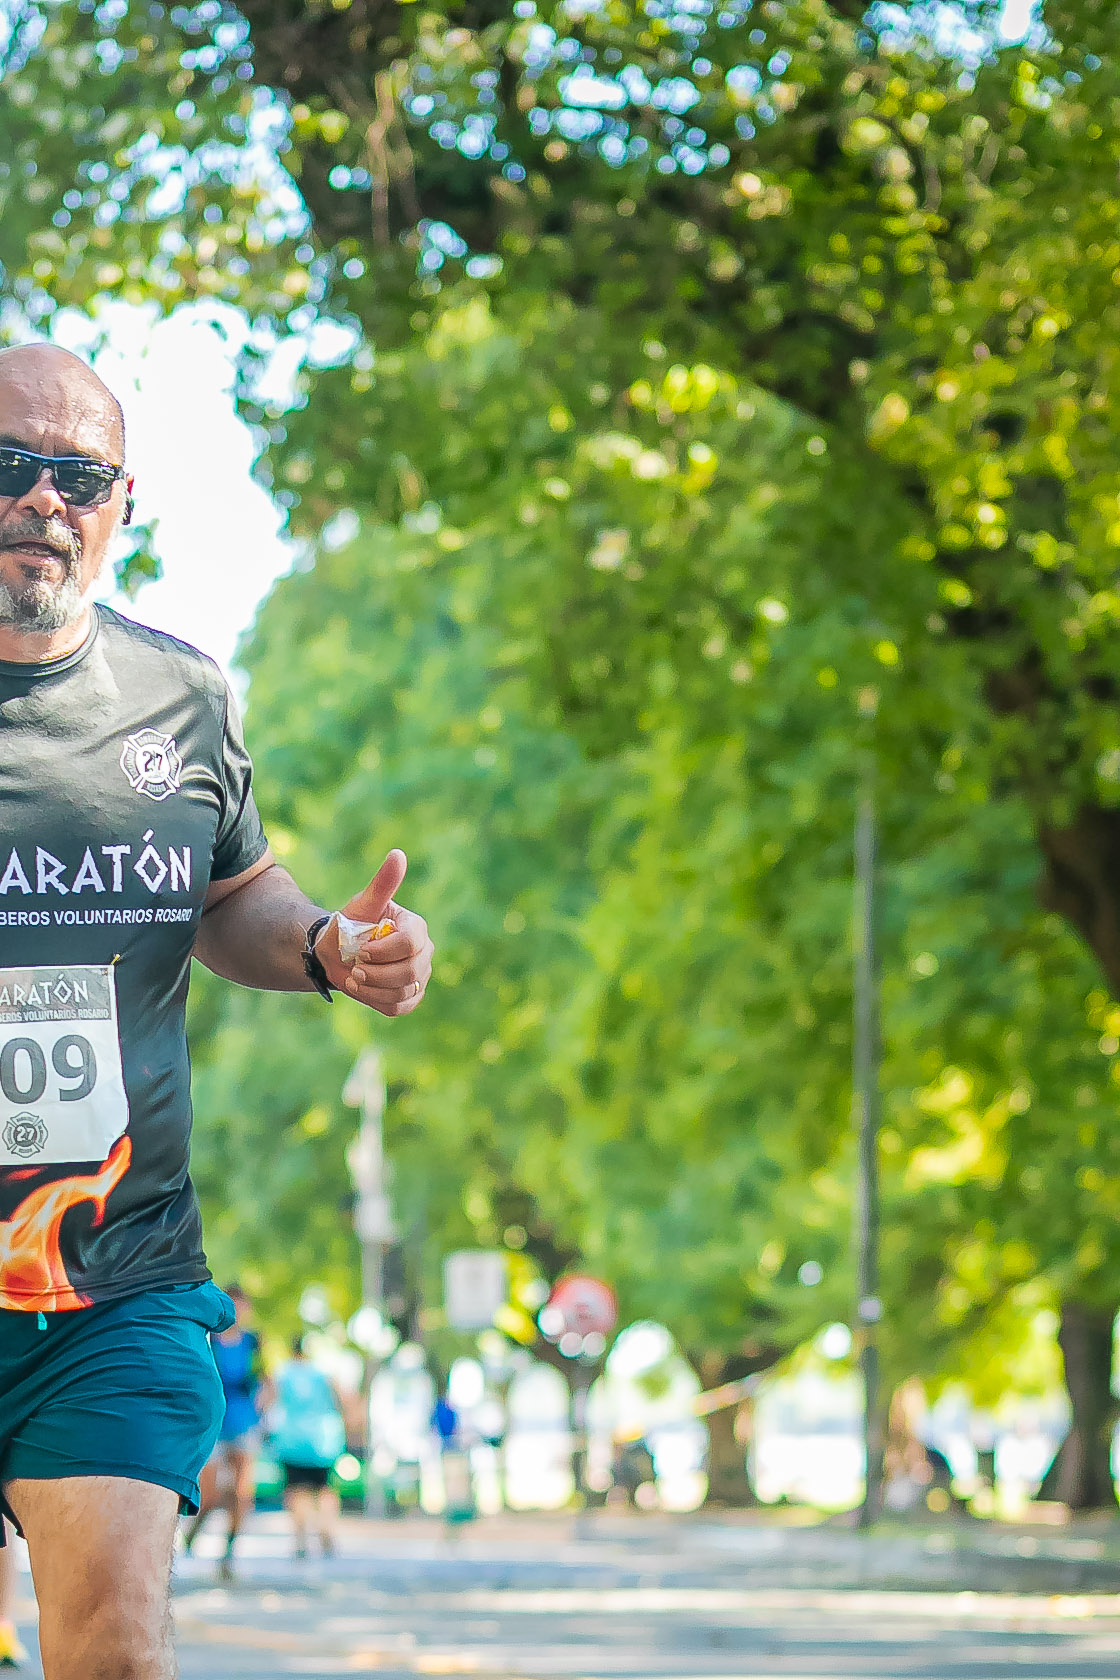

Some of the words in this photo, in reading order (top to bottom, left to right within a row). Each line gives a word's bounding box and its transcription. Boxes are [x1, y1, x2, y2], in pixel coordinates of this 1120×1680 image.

[143, 750, 163, 773] 27
[53, 908, 154, 925] VOLUNTARIOS
[154, 907, 193, 923] ROSARIO
[16, 1125, 35, 1142] 27
